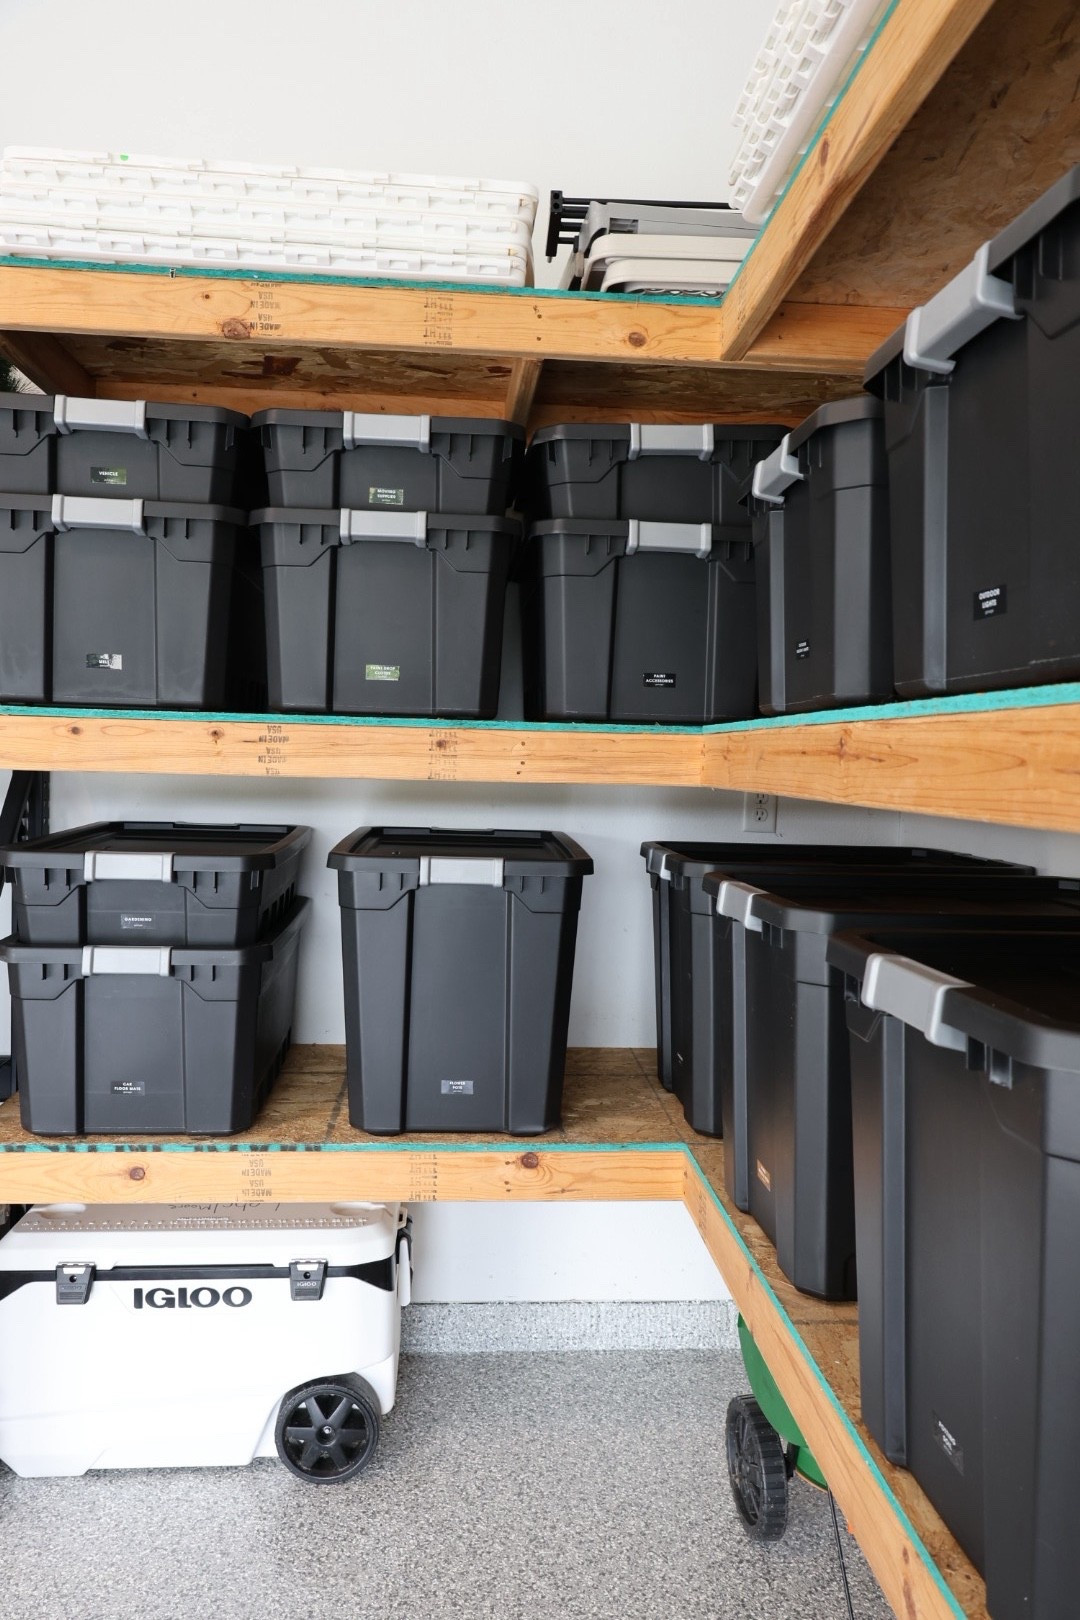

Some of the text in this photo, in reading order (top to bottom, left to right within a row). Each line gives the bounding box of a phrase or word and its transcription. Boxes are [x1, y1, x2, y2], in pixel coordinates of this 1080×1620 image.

[978, 588, 1000, 600] OUTDOOR
[249, 1159, 264, 1168] USA
[250, 1168, 272, 1177] MADE
[249, 1180, 264, 1188] USA
[250, 1188, 272, 1197] MADE
[133, 1286, 252, 1309] IGLOO
